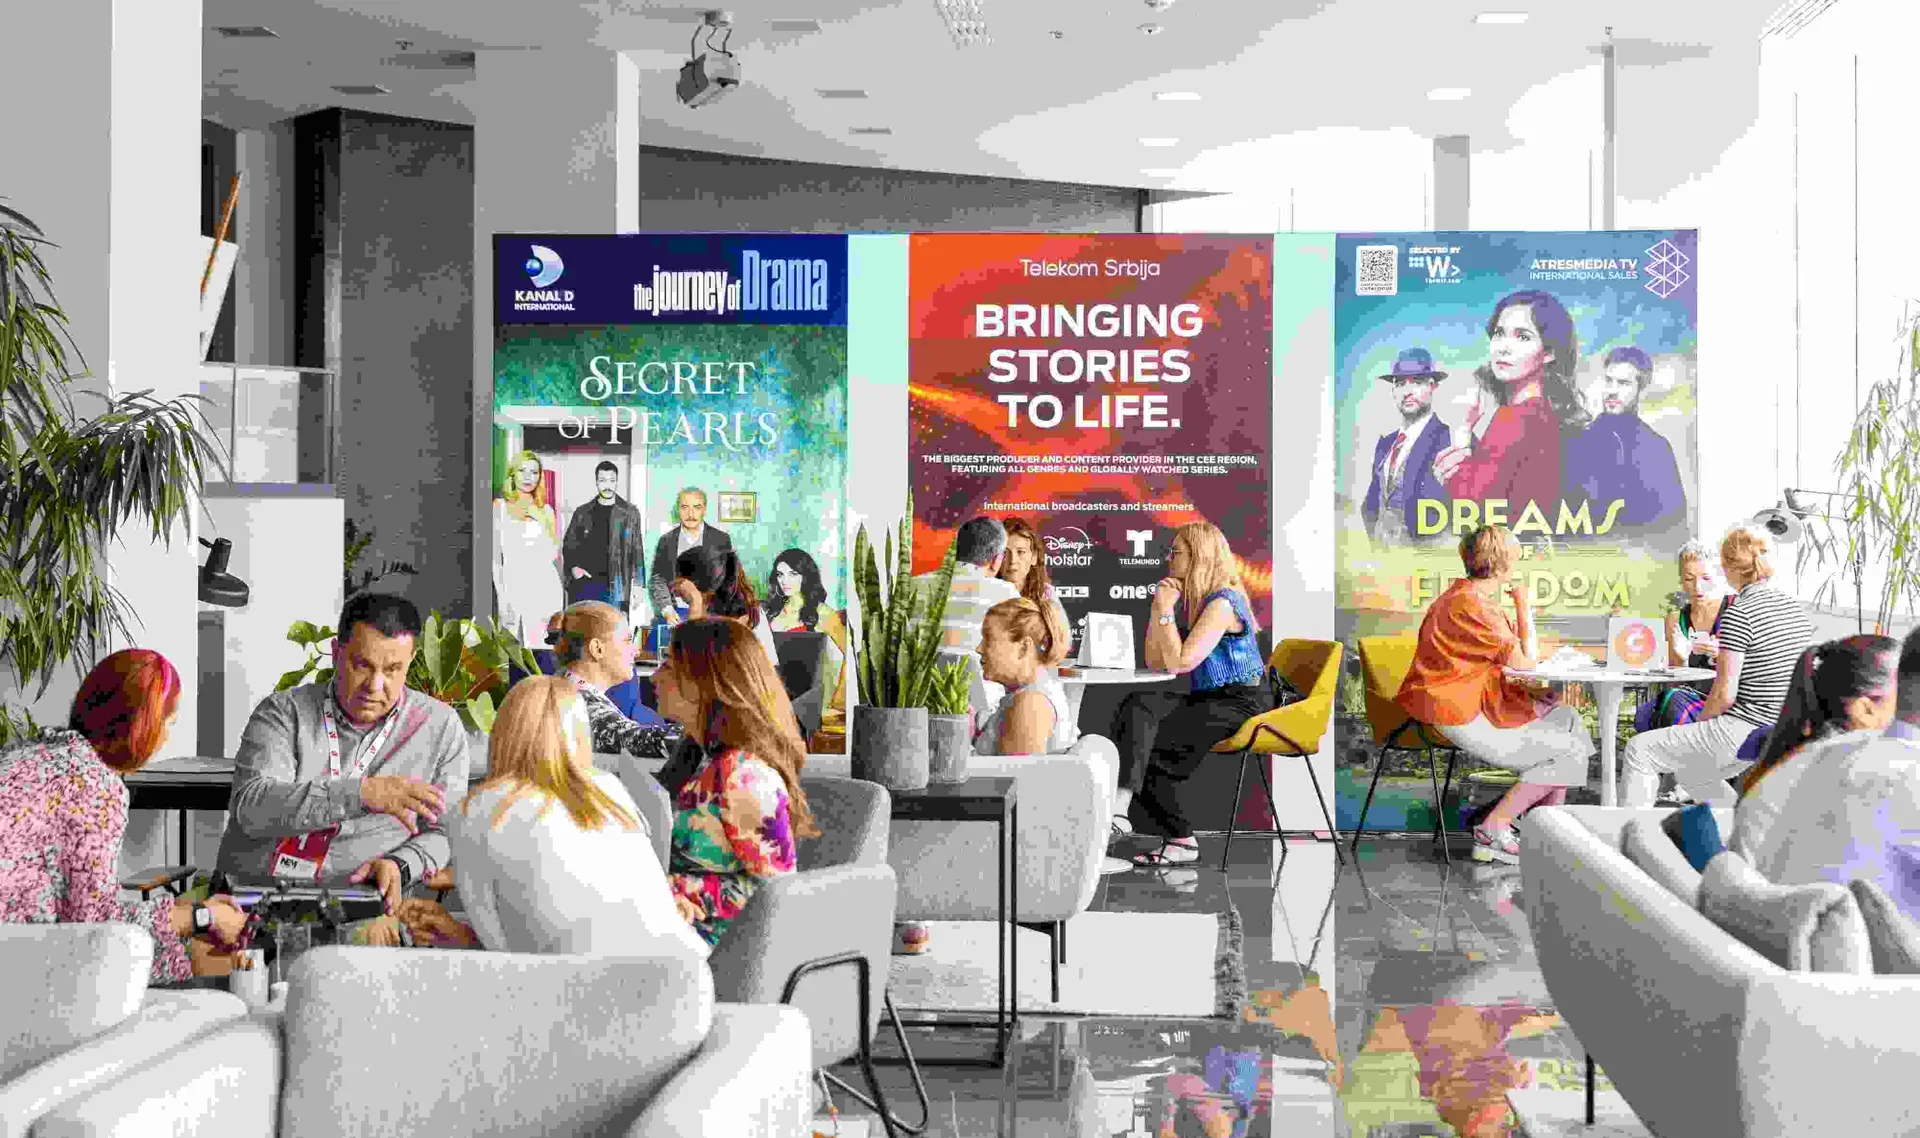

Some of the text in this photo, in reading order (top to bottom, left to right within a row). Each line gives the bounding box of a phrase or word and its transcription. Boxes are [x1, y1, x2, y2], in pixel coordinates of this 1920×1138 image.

[1019, 258, 1161, 280] Telekom Srbija
[1531, 259, 1638, 270] ATRESMEDIA TV
[1530, 271, 1638, 280] INTERNATIONAL SALES
[633, 249, 828, 316] the journey of Drama
[515, 290, 575, 301] KANAL D
[514, 303, 575, 311] INTERNATIONAL
[975, 304, 1203, 338] BRINGING
[988, 349, 1191, 384] STORIES
[998, 395, 1182, 429] TO LIFE.
[922, 455, 1258, 465] THE BIGGEST PRODUCER AND CONTENT PROVIDER IN THE CEE REGION,
[952, 465, 1229, 474] FEATURING ALL GENRES AND GLOBALLY WATCHED SERIES.
[983, 501, 1194, 511] International broadcasters and streamers
[1416, 498, 1626, 535] DREAMS
[1044, 553, 1092, 566] hotstar
